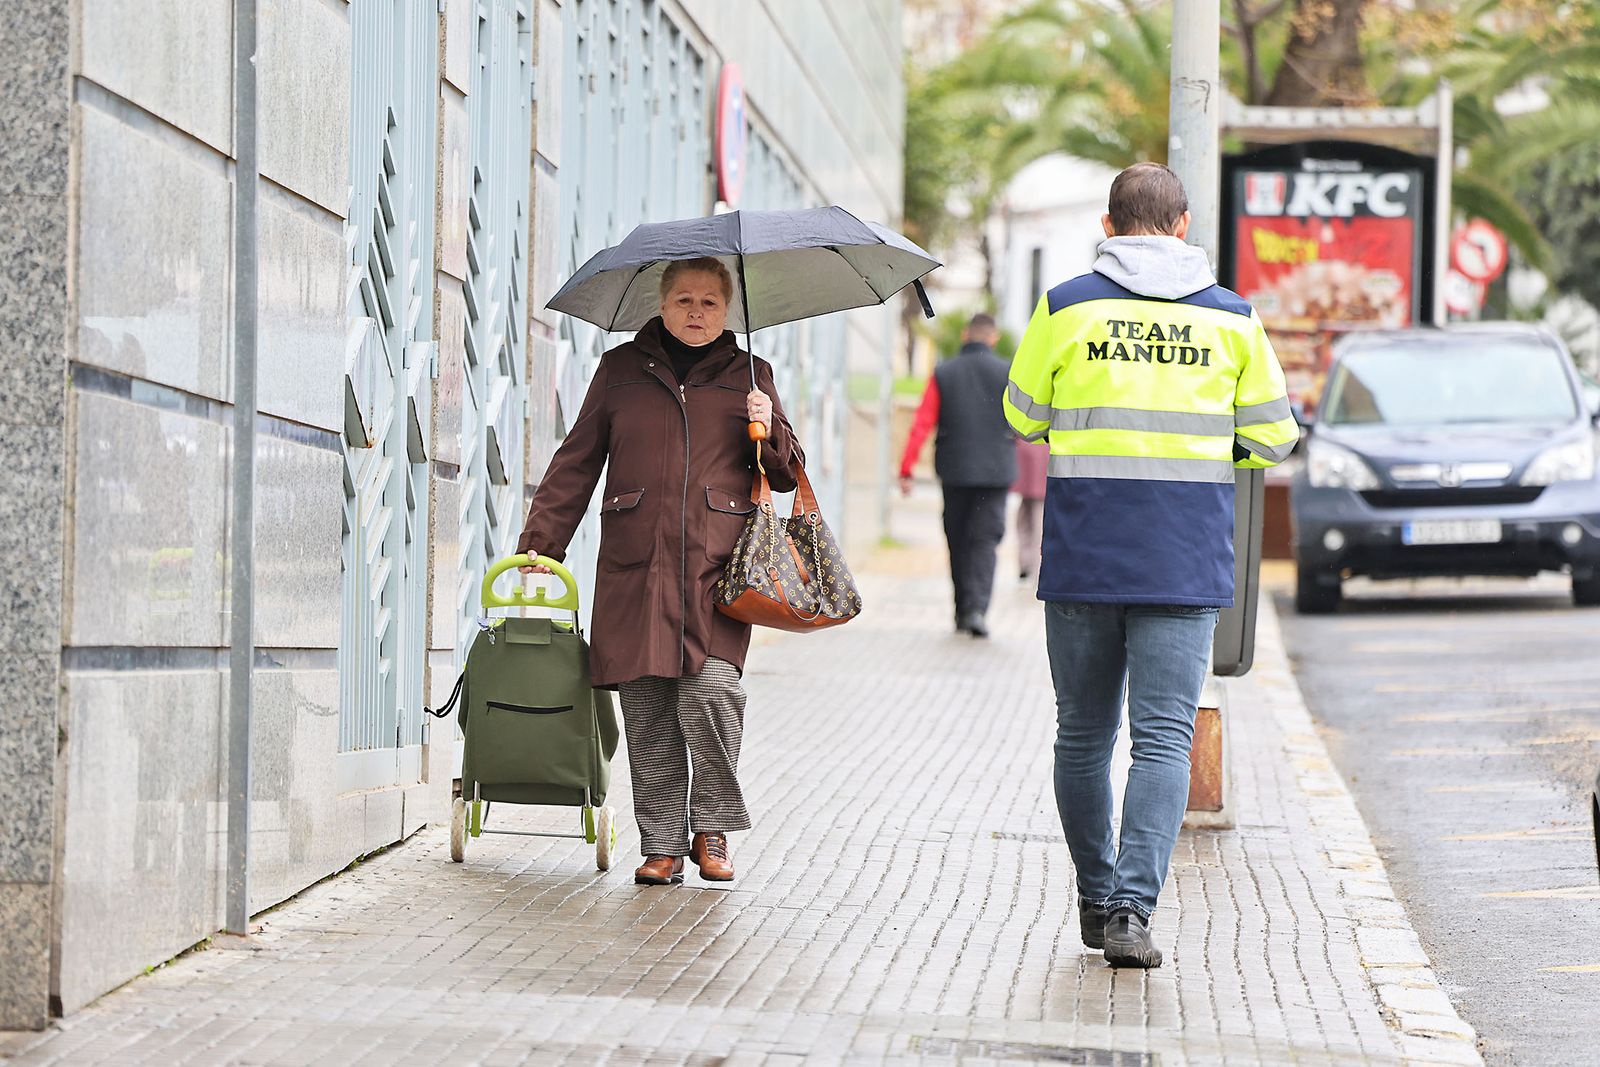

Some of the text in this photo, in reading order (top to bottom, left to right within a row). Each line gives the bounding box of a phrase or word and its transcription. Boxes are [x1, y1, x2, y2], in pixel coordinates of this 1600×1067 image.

[1286, 172, 1411, 217] KFC
[1106, 319, 1192, 343] TEAM
[1086, 341, 1212, 367] MANUDI
